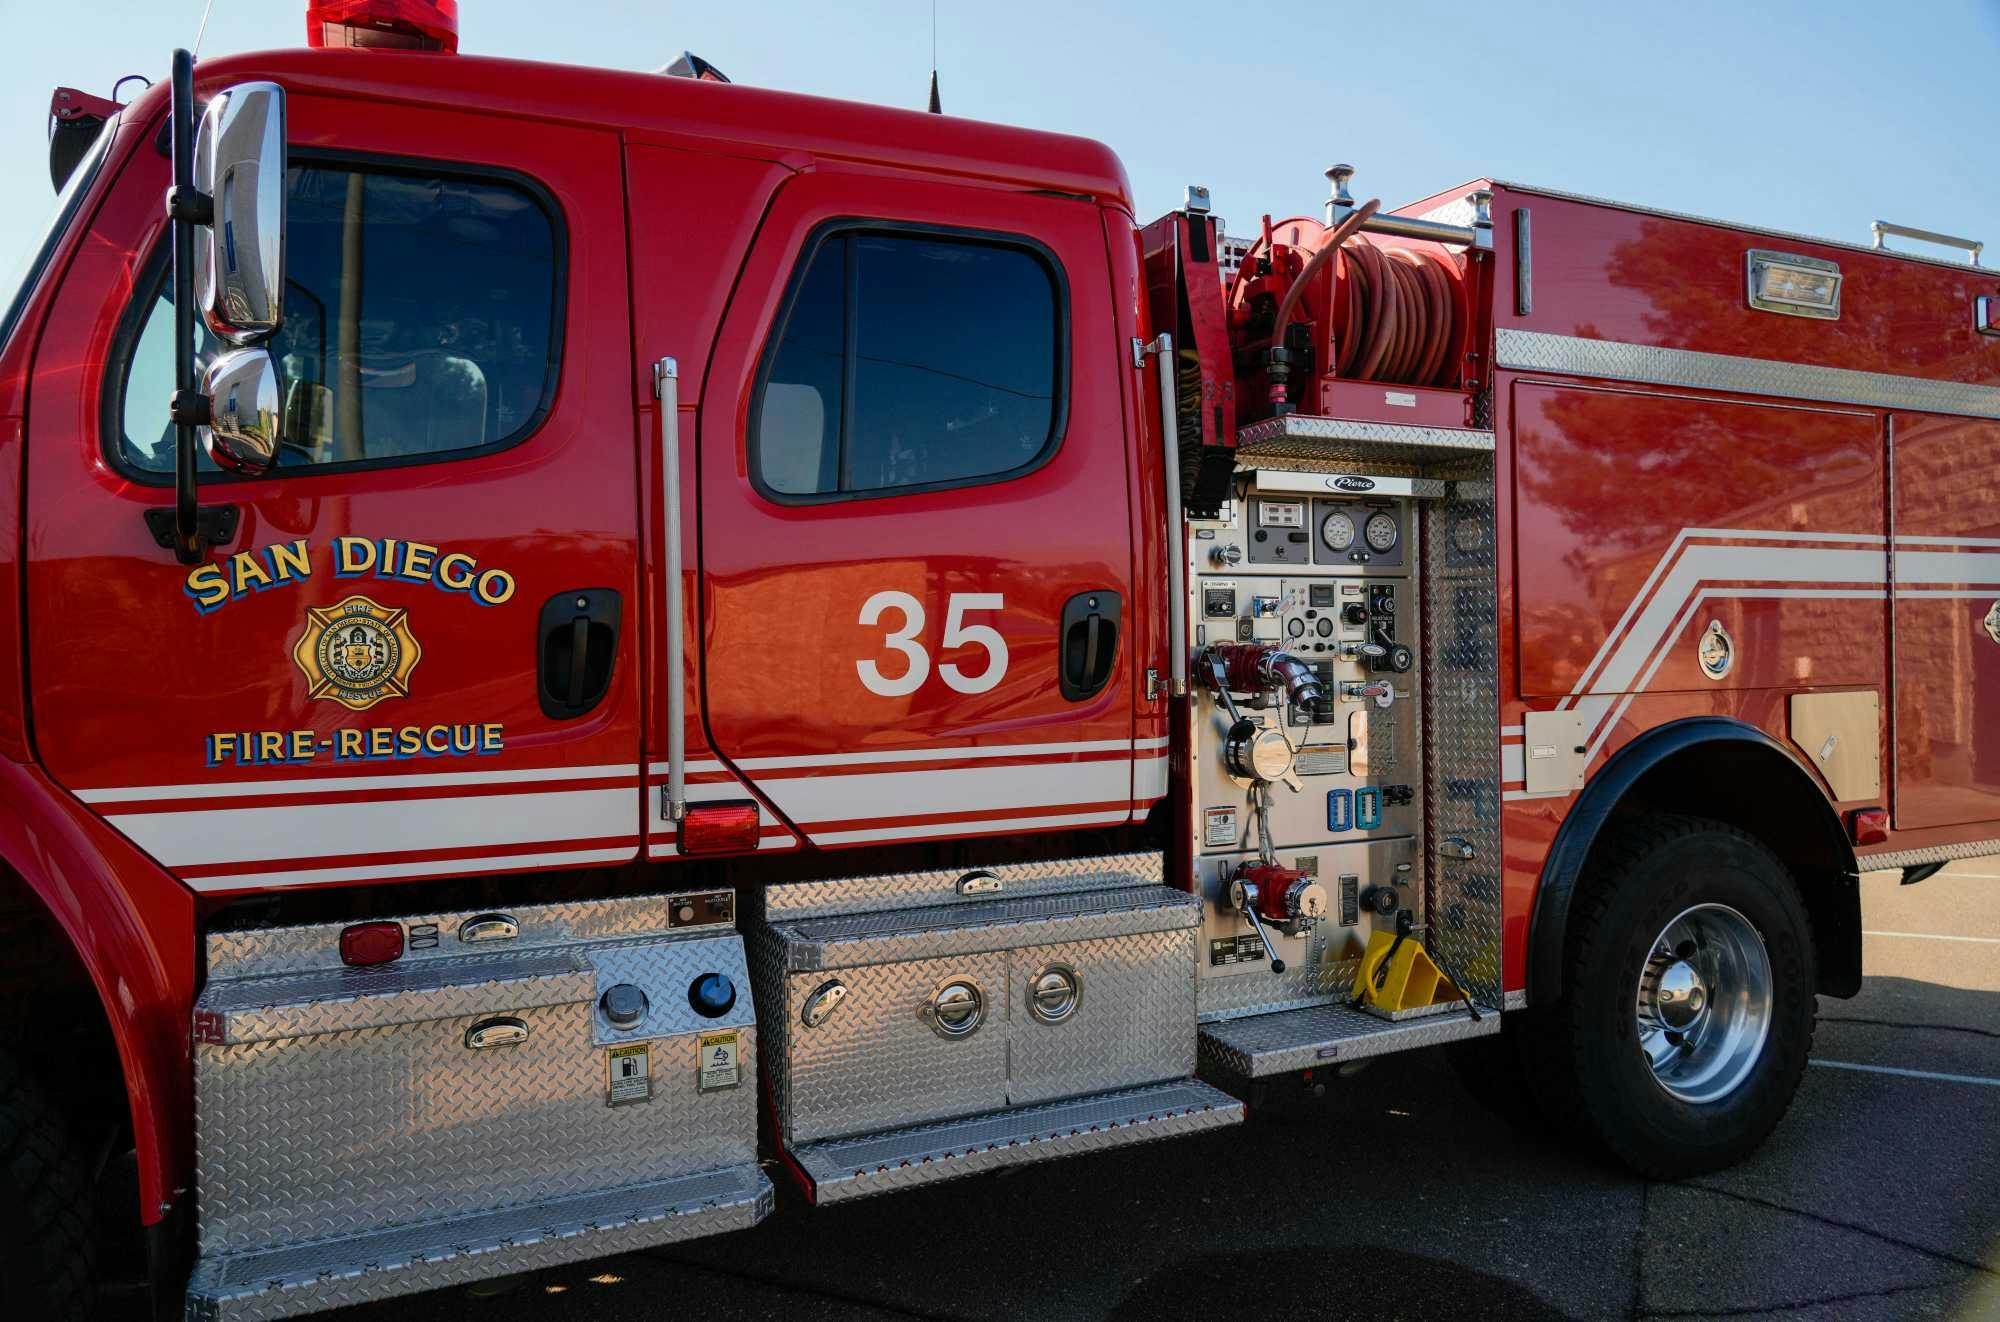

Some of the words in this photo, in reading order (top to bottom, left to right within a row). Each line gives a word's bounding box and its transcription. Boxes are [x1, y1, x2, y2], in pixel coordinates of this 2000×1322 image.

[1337, 478, 1373, 488] Pierce
[184, 538, 312, 615] SAN
[332, 536, 515, 606] DIEGO
[344, 605, 374, 615] FIRE
[857, 590, 1008, 696] 35
[337, 688, 384, 700] RESCUE
[206, 723, 505, 768] FIRE-RESCUE
[709, 1035, 735, 1044] CAUTION
[619, 1046, 646, 1056] CAUTION
